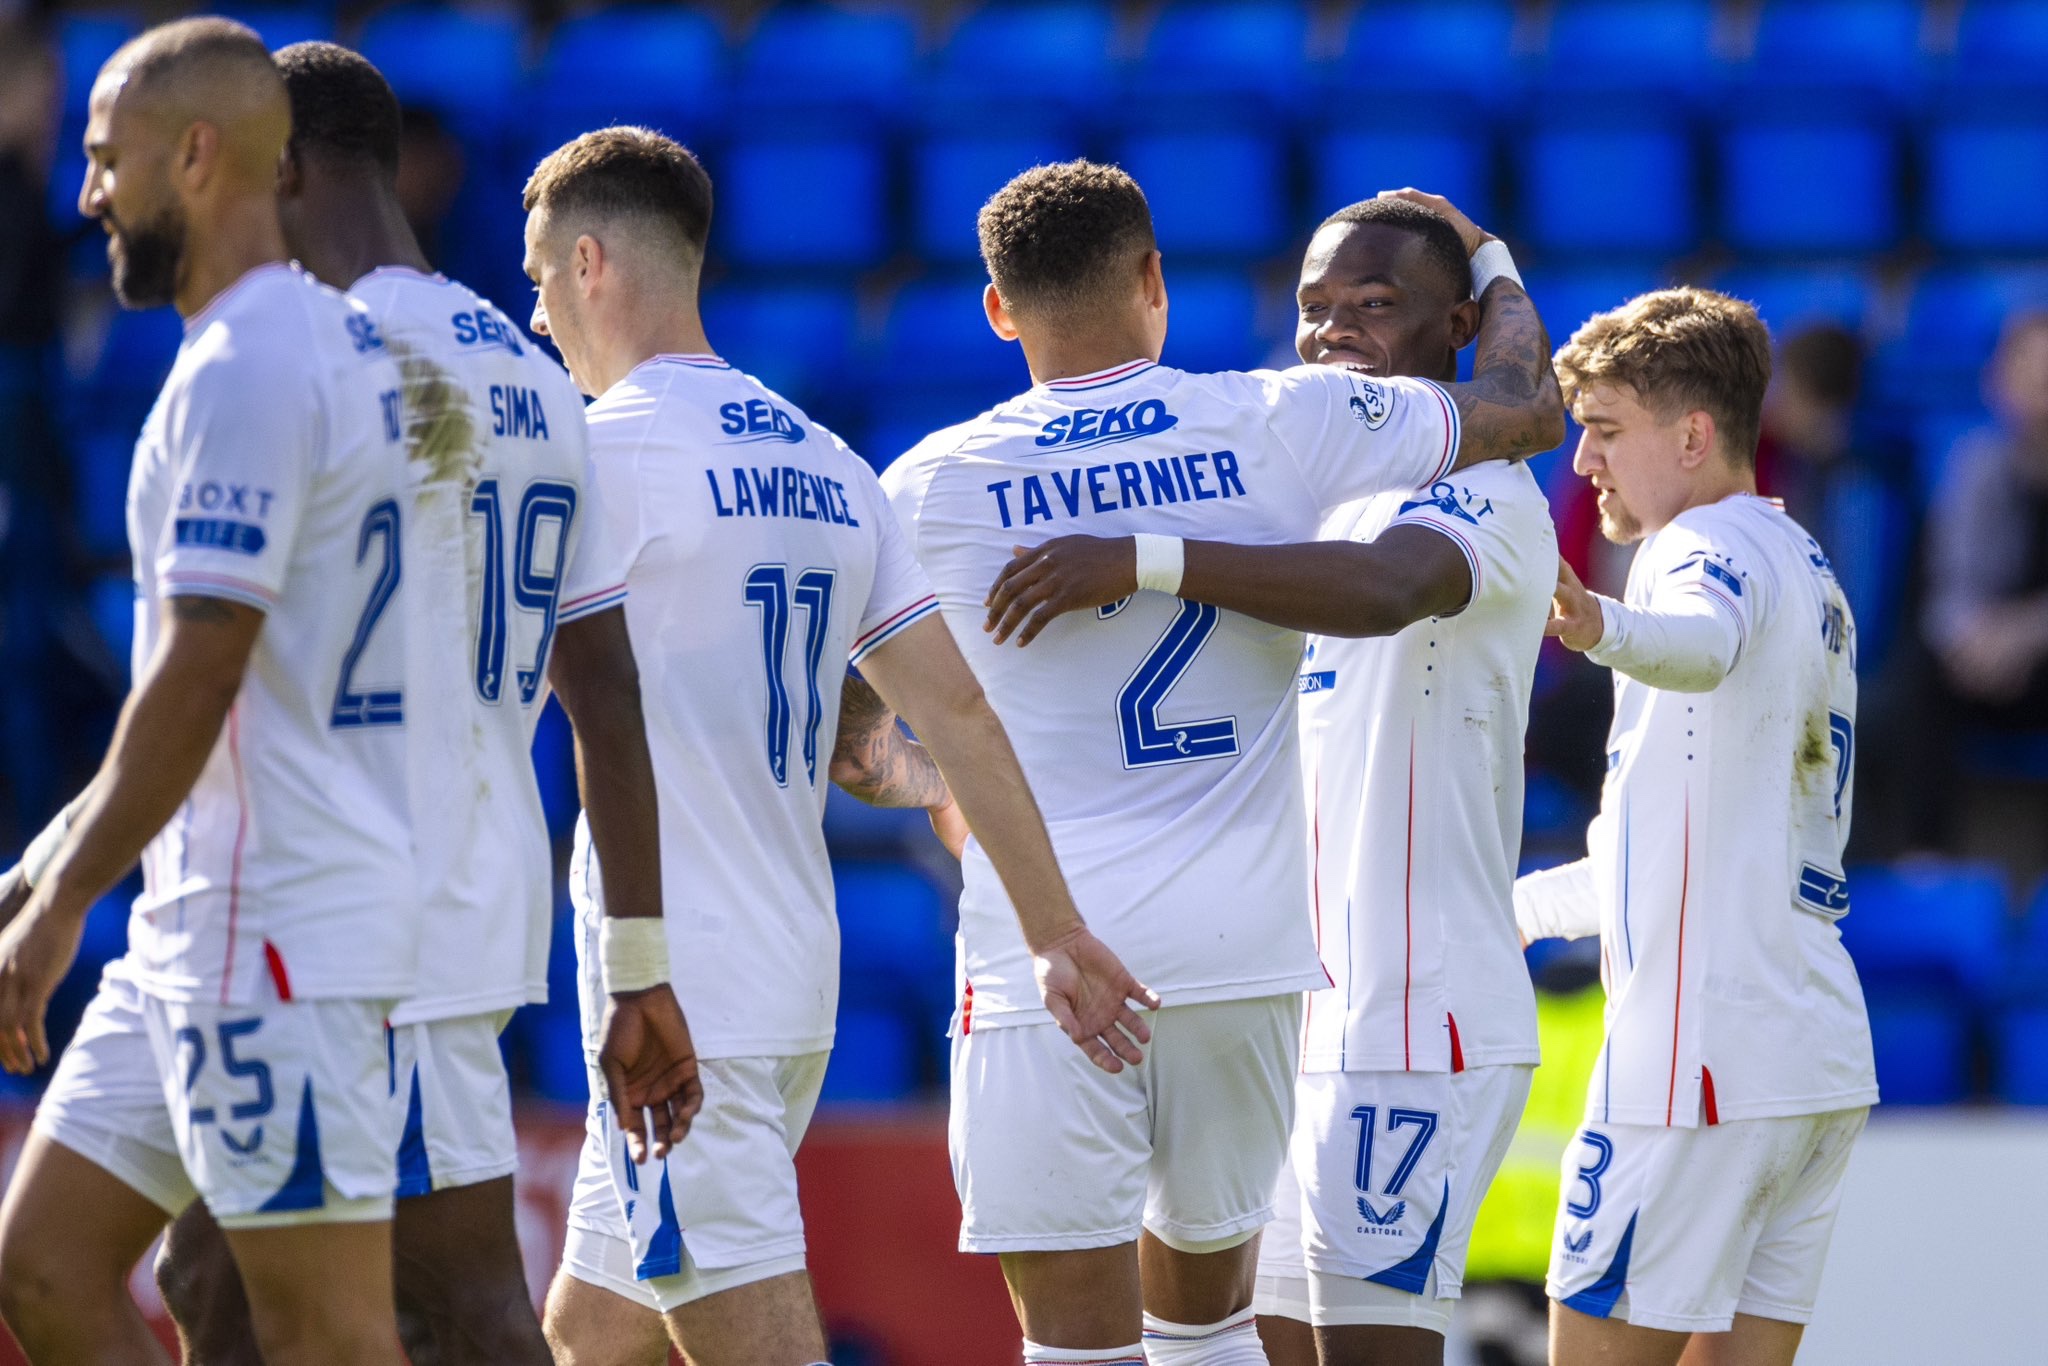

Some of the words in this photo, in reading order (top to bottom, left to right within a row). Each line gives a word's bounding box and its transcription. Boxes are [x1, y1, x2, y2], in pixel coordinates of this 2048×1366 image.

[489, 384, 549, 440] SIMA
[1034, 398, 1179, 448] SEKO
[705, 466, 860, 528] LAWRENCE
[987, 449, 1247, 528] TAVERNIER
[470, 474, 578, 708] 19
[742, 562, 837, 793] 11
[1096, 594, 1241, 771] 2
[175, 1016, 275, 1124] 25
[1349, 1103, 1441, 1198] 17
[1357, 1226, 1404, 1237] CASTORE
